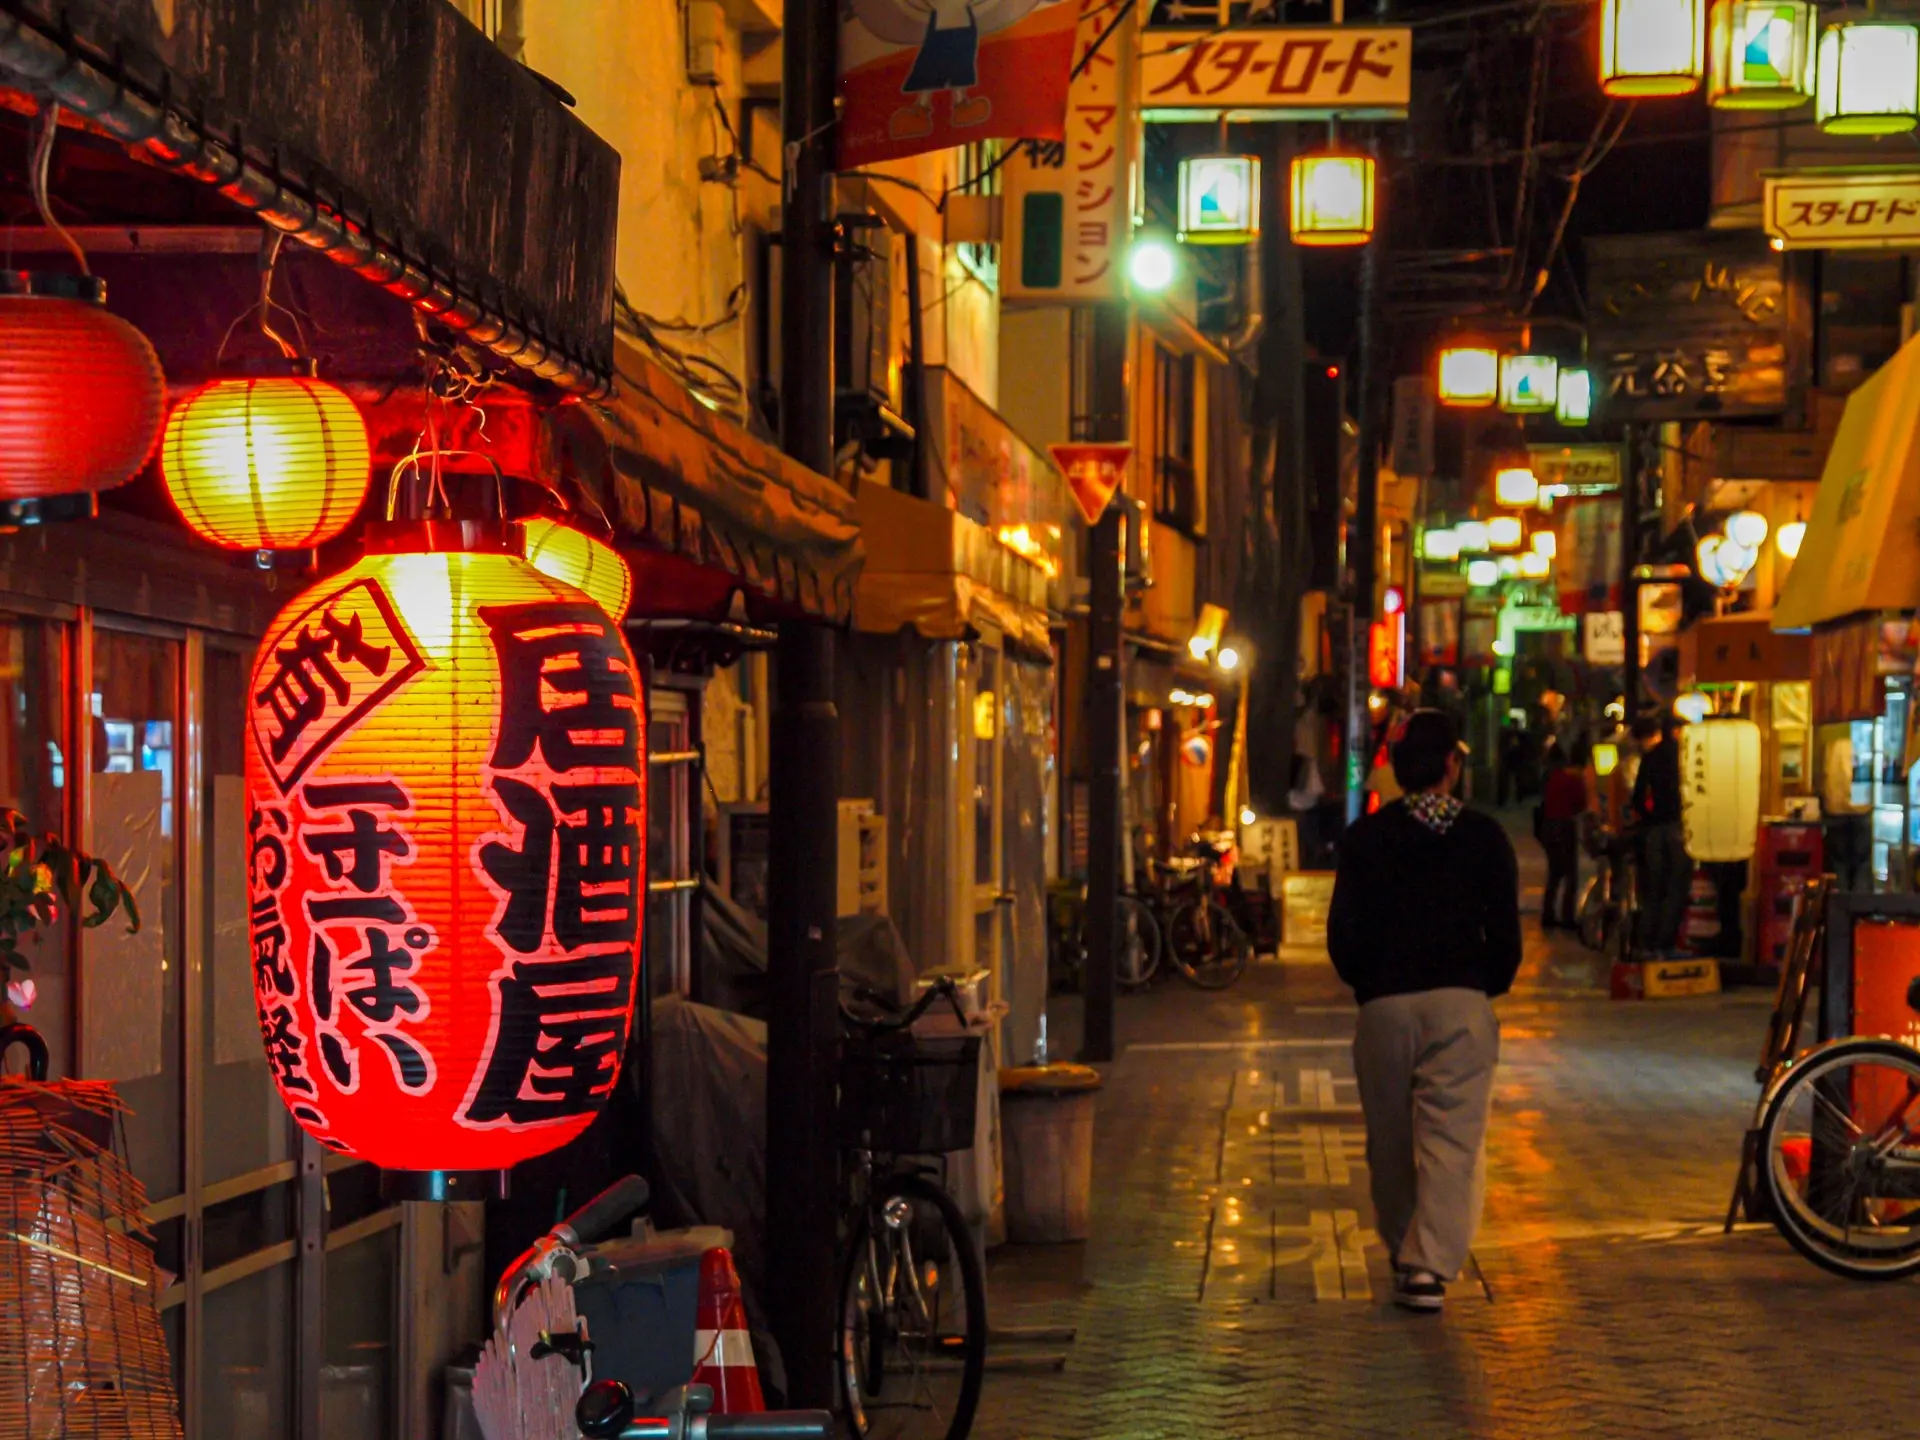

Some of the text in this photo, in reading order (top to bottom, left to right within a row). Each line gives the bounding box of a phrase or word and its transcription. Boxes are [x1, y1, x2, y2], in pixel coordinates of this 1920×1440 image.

[1149, 38, 1398, 95] スターロード
[1789, 199, 1920, 227] スターロード
[302, 781, 430, 1088] 一寸一ぱい
[465, 605, 643, 1123] 居酒屋
